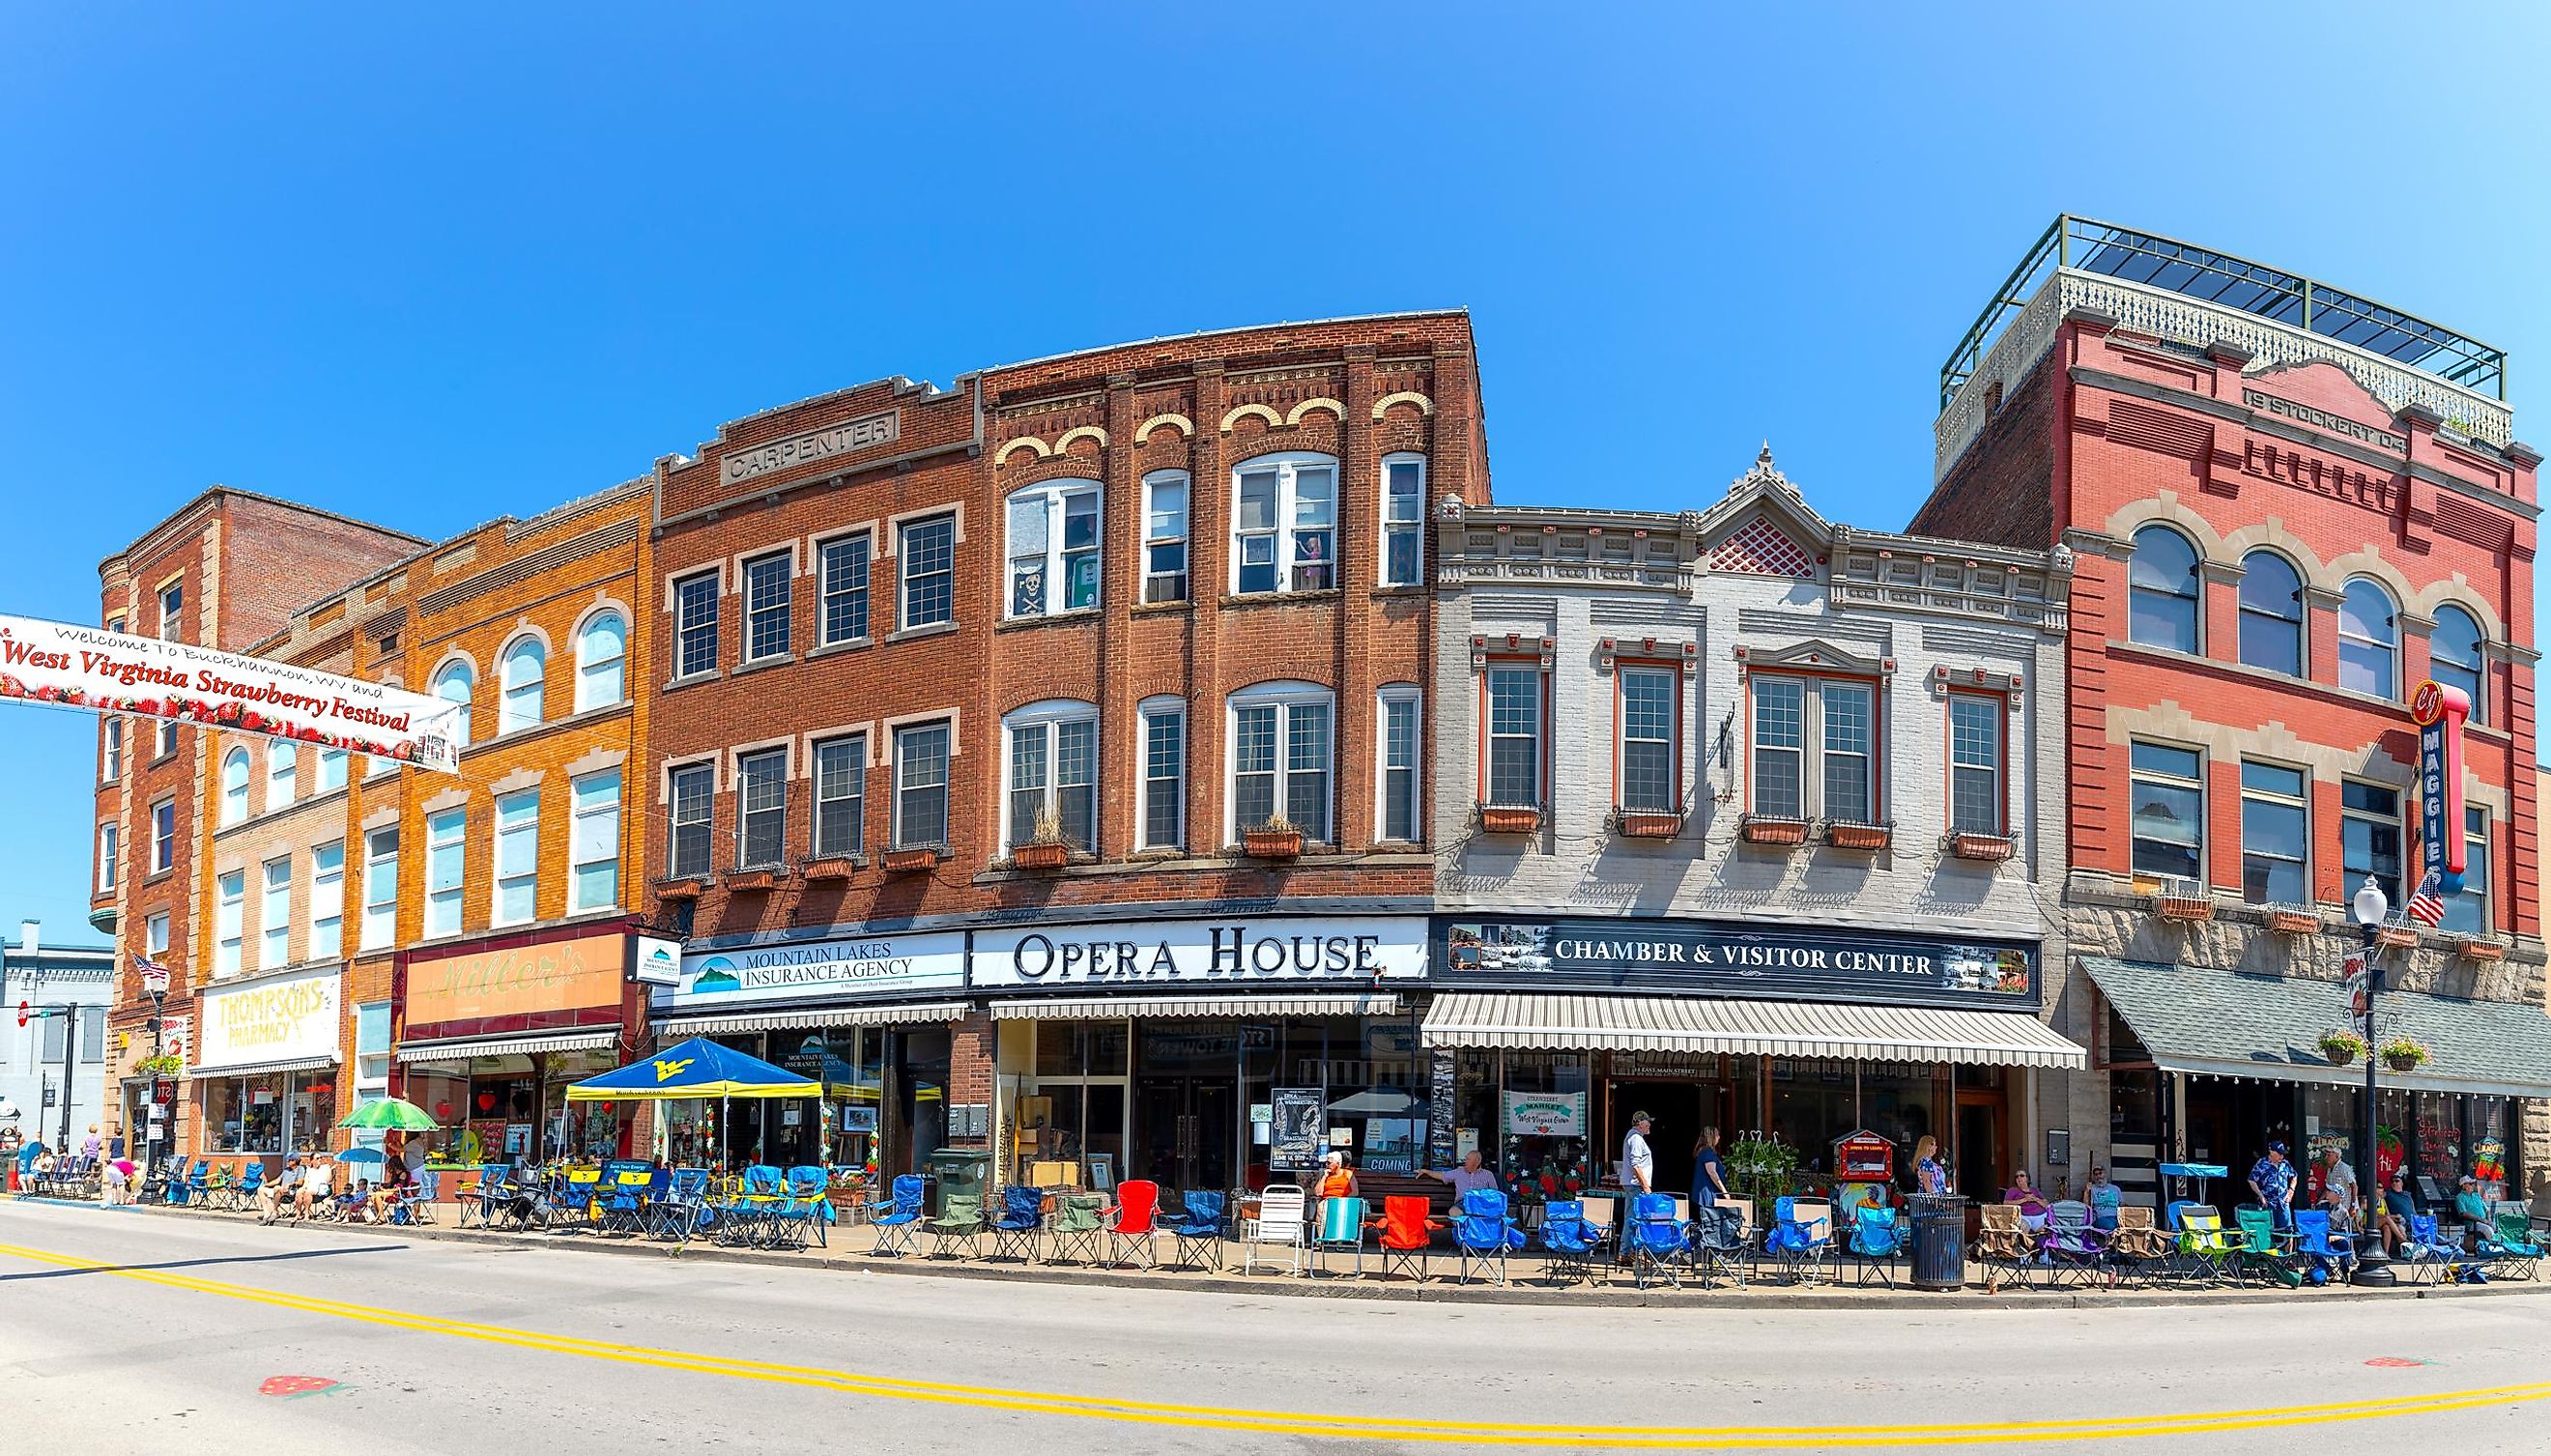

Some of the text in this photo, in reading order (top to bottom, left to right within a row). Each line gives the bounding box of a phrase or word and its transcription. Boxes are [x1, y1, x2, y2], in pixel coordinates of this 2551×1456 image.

[2244, 388, 2407, 454] 19 STOCKERT 04
[730, 420, 888, 478] CARPENTER
[3, 639, 411, 732] West Virginia Strawberry Festival
[55, 627, 385, 699] Welcome To Buckhannon, WV and
[2422, 730, 2442, 885] MAGGIES
[427, 944, 586, 1000] Miller's
[746, 942, 892, 969] MOUNTAIN LAKES
[746, 958, 913, 986] INSURANCE AGENCY
[1014, 927, 1380, 979] OPERA HOUSE
[1555, 939, 1934, 975] CHAMBER & VISITOR CENTER
[218, 980, 322, 1028] THOMPSONS
[229, 1021, 290, 1046] PHARMACY
[1370, 1158, 1412, 1171] COMING
[2378, 1154, 2393, 1172] Hi
